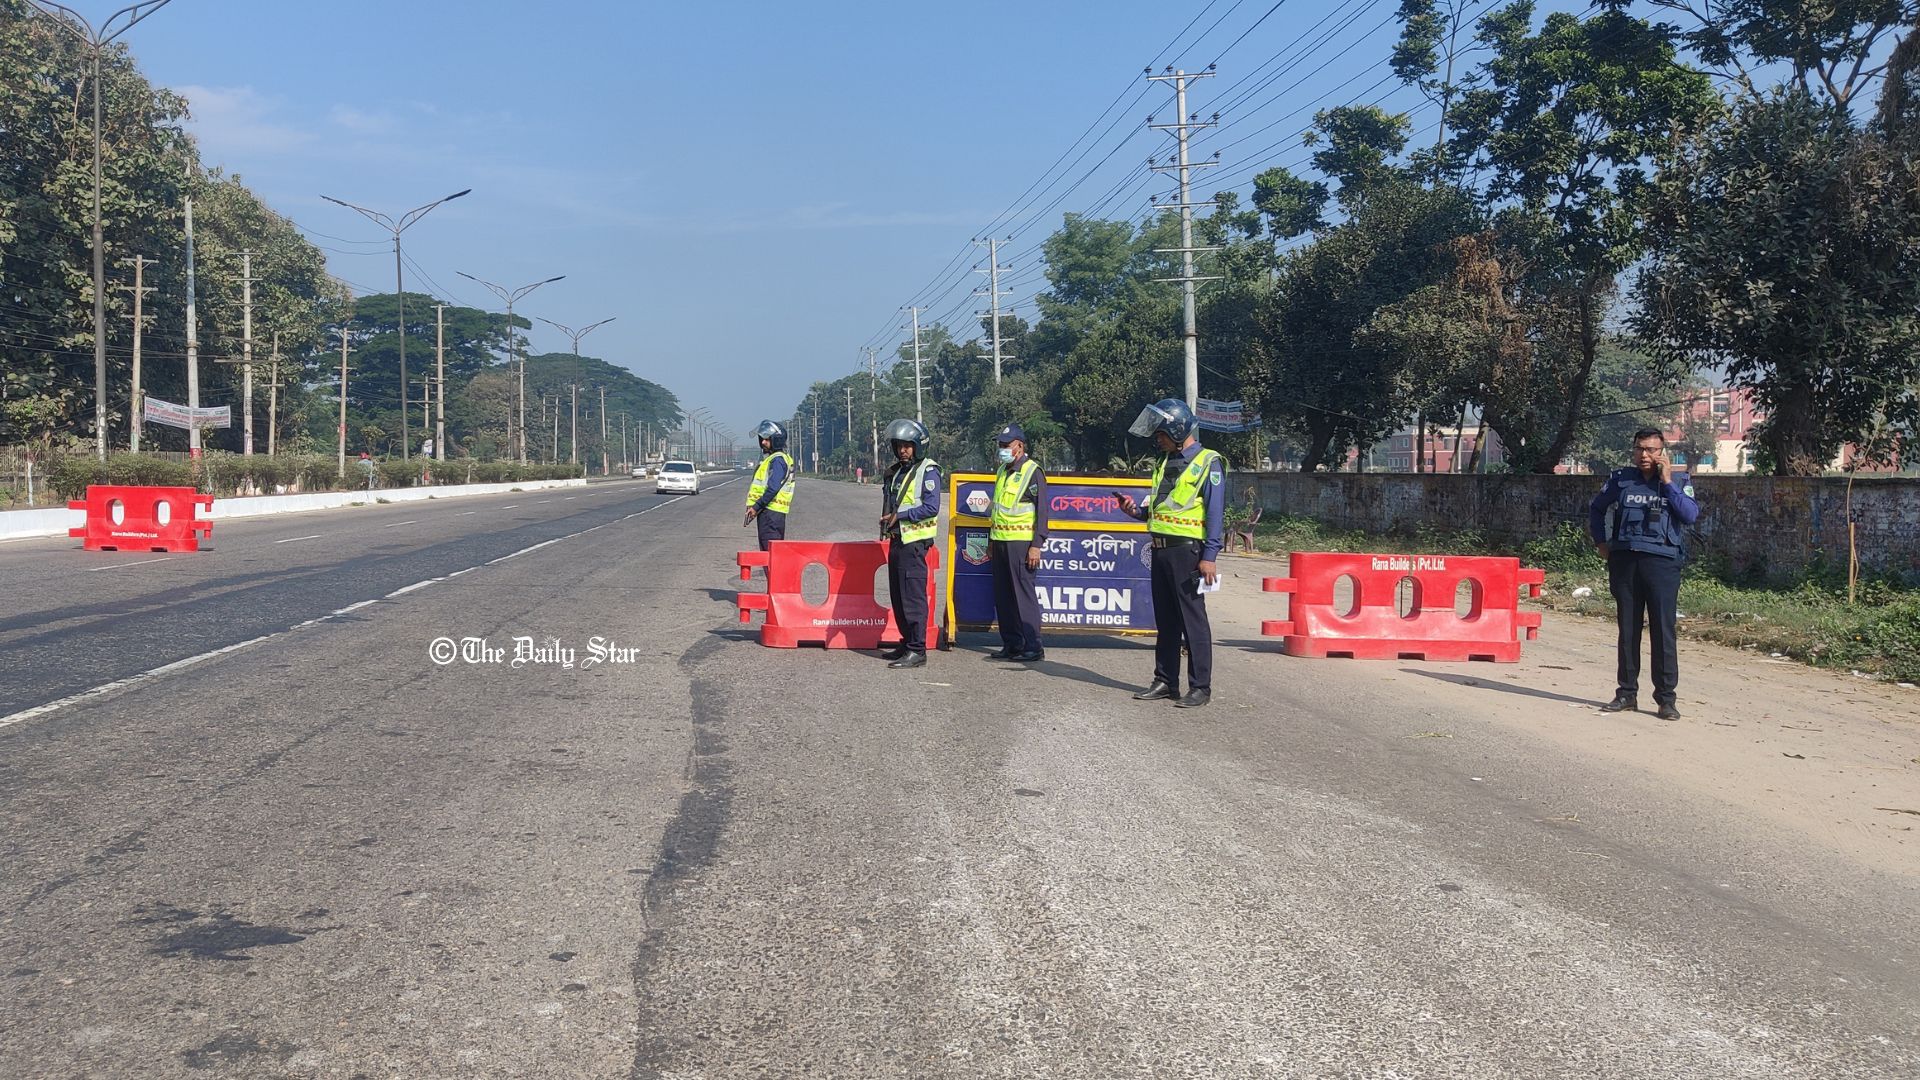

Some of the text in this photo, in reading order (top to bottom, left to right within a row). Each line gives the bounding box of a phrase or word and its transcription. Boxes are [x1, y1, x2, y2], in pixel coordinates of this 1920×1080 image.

[968, 497, 988, 506] STOP
[1081, 534, 1138, 560] পুলিশ
[1038, 559, 1116, 572] IVE SLOW
[1372, 557, 1388, 571] Rana
[1035, 585, 1132, 612] ALTON
[812, 618, 830, 626] Rana
[830, 618, 856, 626] Builders
[1041, 613, 1130, 625] SMART FRIDGE
